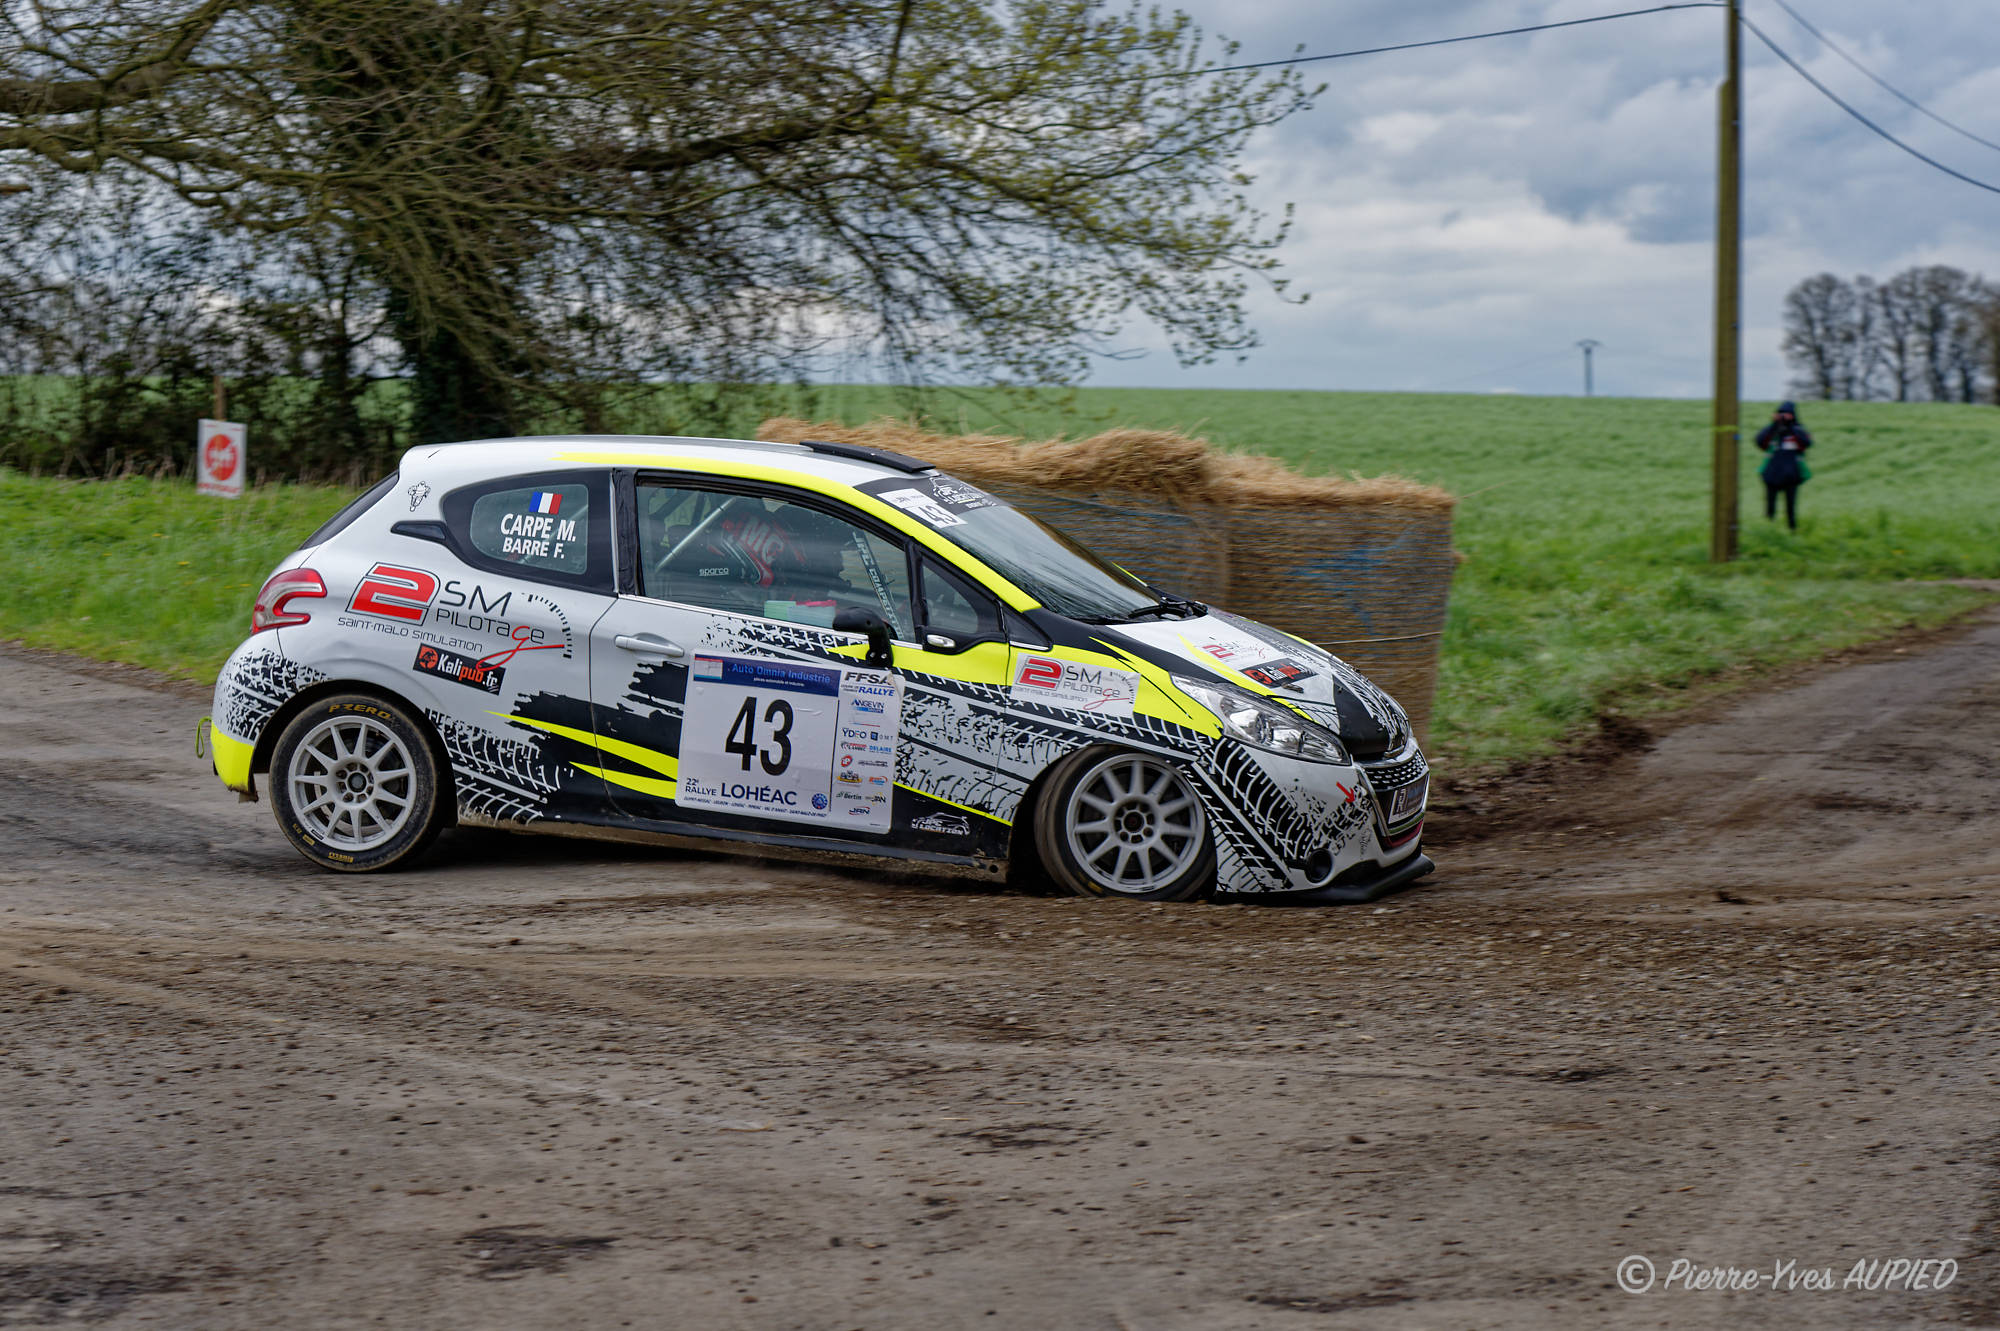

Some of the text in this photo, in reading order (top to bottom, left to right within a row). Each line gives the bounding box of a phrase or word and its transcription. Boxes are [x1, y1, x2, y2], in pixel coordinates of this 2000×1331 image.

[918, 505, 958, 524] 43
[501, 513, 577, 542] CARPE M.
[502, 537, 565, 559] BARRE F.
[699, 567, 729, 577] sparco
[731, 662, 755, 675] Auto
[756, 666, 786, 679] Omnia
[788, 670, 831, 684] Industrie
[844, 671, 892, 686] FFSA
[858, 686, 895, 697] RALLYE
[725, 696, 794, 776] 43
[684, 785, 717, 796] RALLYE
[720, 782, 798, 806] LOHÉAC
